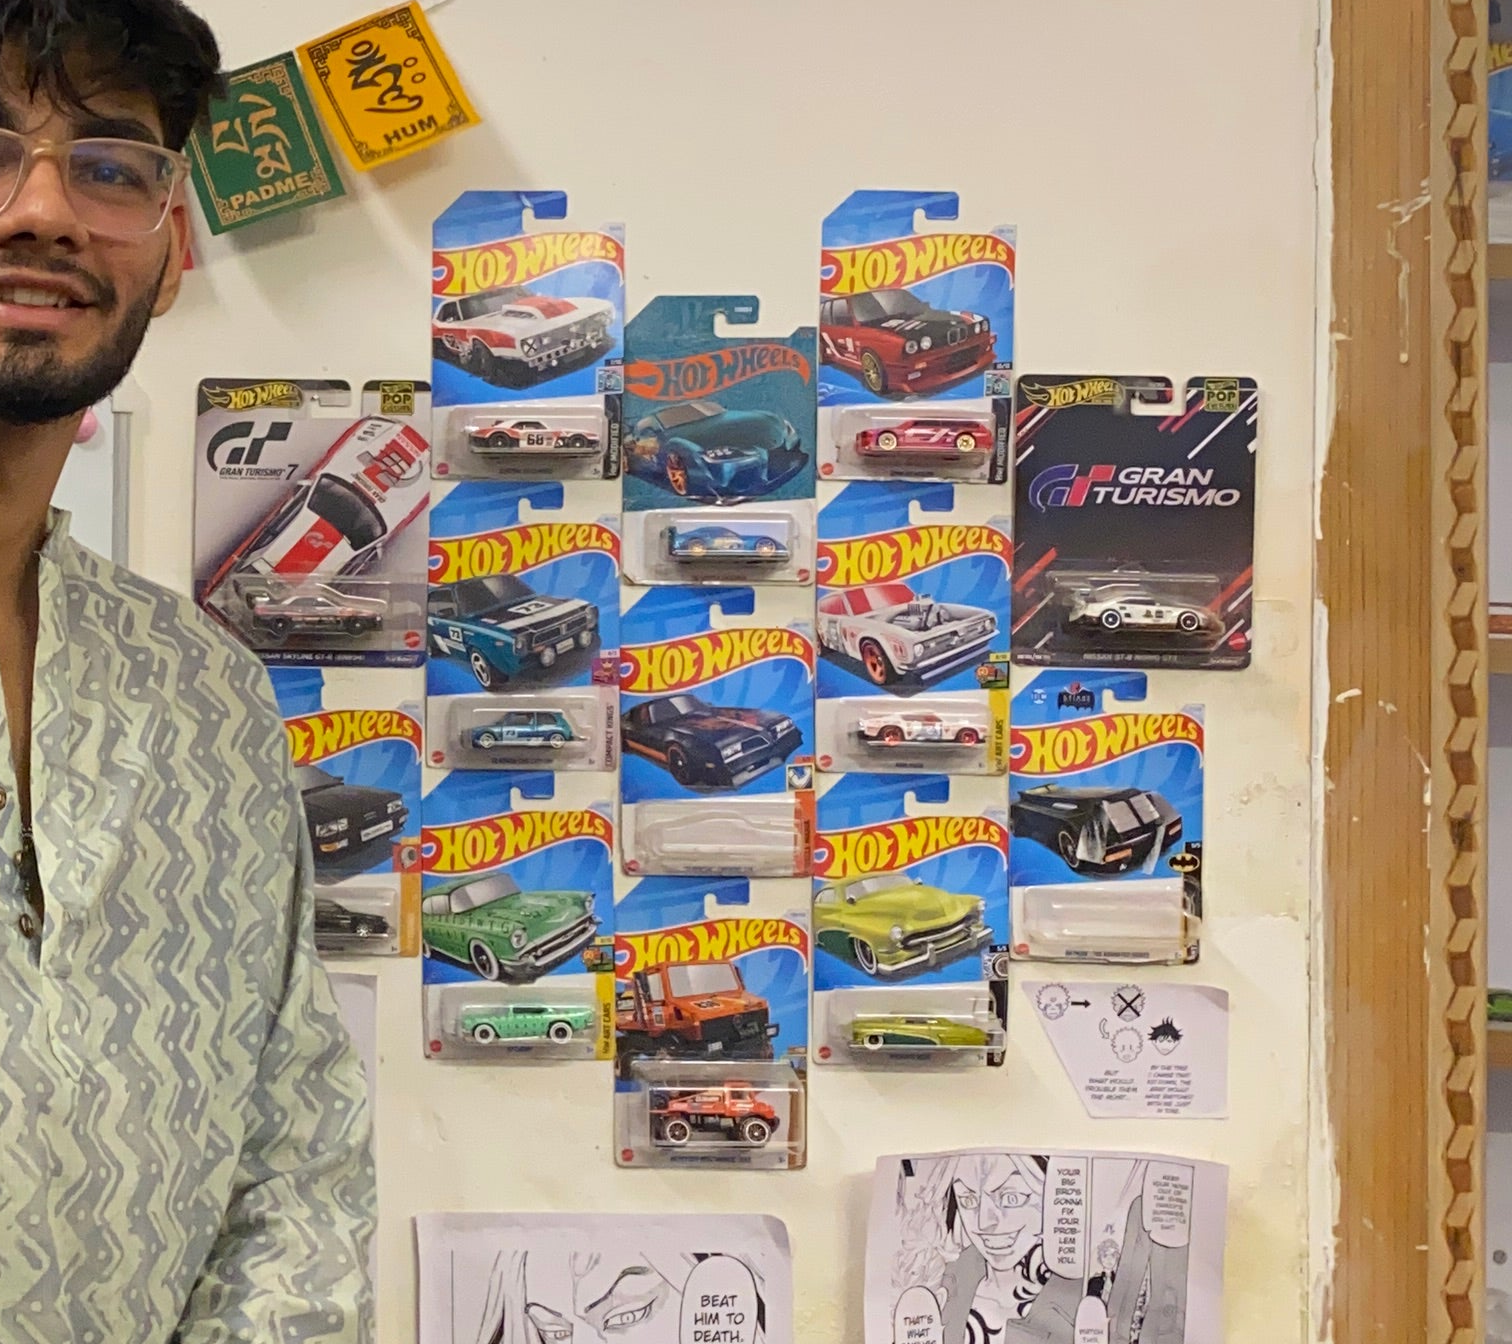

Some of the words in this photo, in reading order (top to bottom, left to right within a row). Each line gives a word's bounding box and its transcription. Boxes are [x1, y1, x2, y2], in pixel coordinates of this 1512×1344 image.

[383, 114, 438, 145] HUM
[229, 173, 312, 209] PADME
[382, 394, 412, 404] POP
[1207, 391, 1236, 402] POP
[219, 467, 244, 476] GRAN
[285, 464, 300, 481] 7
[1118, 467, 1214, 486] GRAN
[1092, 487, 1241, 507] TURISMO
[701, 1294, 738, 1307] BEAT
[694, 1312, 720, 1326] HIM
[726, 1312, 745, 1325] TO
[903, 1314, 934, 1326] THAT'S
[694, 1330, 745, 1343] DEATH.
[906, 1327, 931, 1339] WHAT
